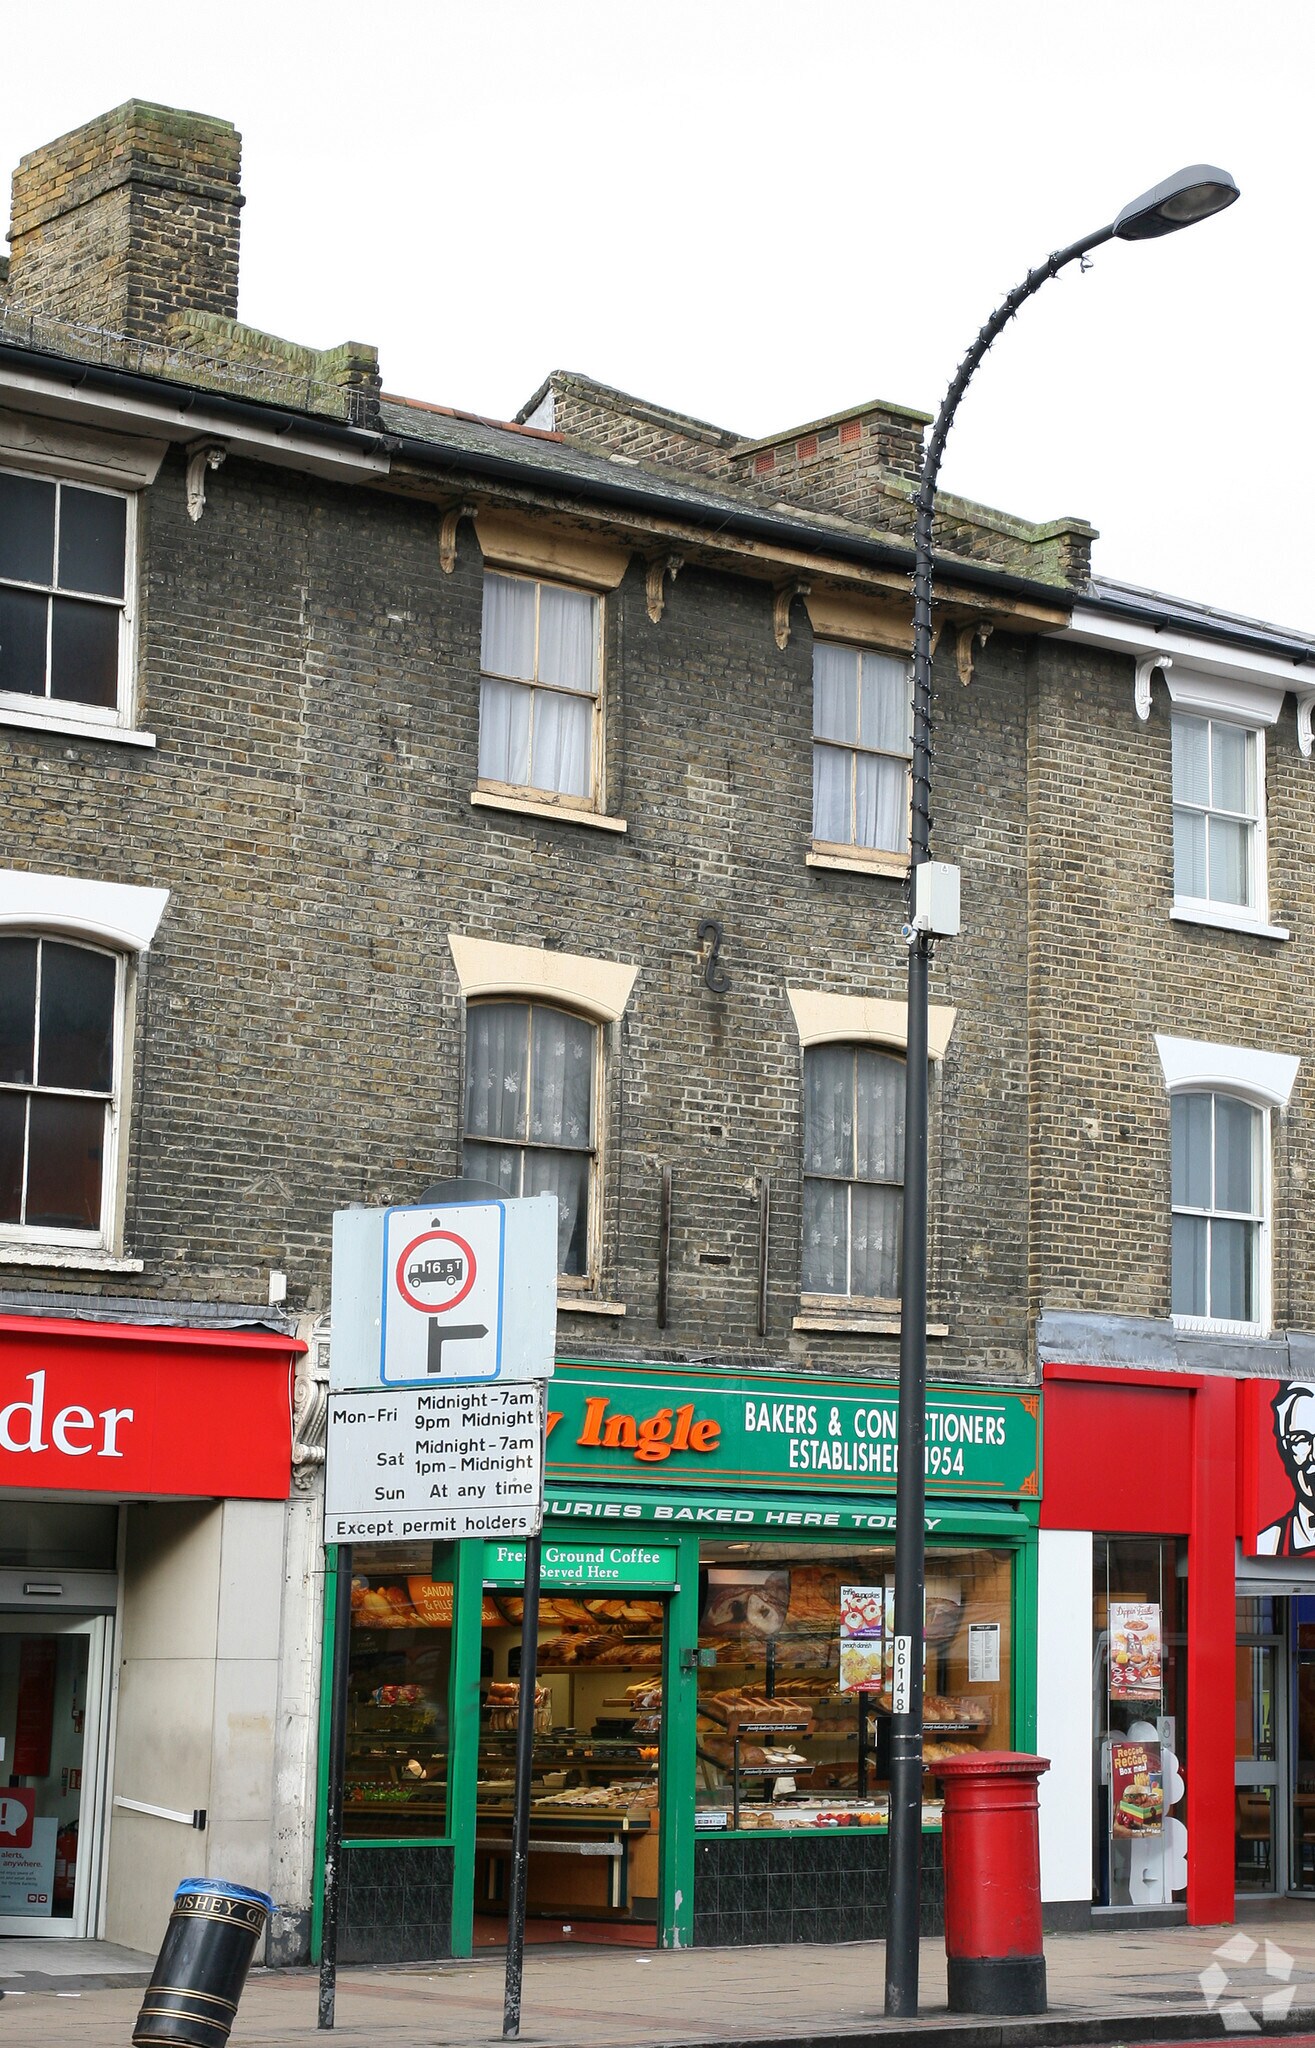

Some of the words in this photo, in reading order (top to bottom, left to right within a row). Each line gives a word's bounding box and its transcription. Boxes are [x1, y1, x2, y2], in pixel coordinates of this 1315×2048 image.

[0, 1369, 135, 1457] der
[415, 1415, 451, 1431] 9pm
[462, 1410, 534, 1427] Midnight
[744, 1401, 817, 1436] BAKERS
[828, 1406, 842, 1437] &
[854, 1407, 1006, 1446] CONTIONERS
[577, 1396, 722, 1462] Ingle
[377, 1452, 405, 1467] Sat
[925, 1446, 965, 1477] 1954
[374, 1487, 405, 1501] Sun
[430, 1484, 448, 1498] At
[458, 1484, 486, 1499] any
[496, 1480, 533, 1496] time
[337, 1520, 394, 1537] Except
[402, 1517, 457, 1535] permit
[465, 1515, 527, 1531] holders
[654, 1505, 754, 1523] BAKED
[765, 1510, 841, 1526] HERE
[546, 1547, 605, 1563] Ground
[610, 1548, 661, 1564] Coffee
[540, 1564, 583, 1578] Served
[587, 1565, 620, 1578] Here
[422, 1585, 454, 1597] SANDW
